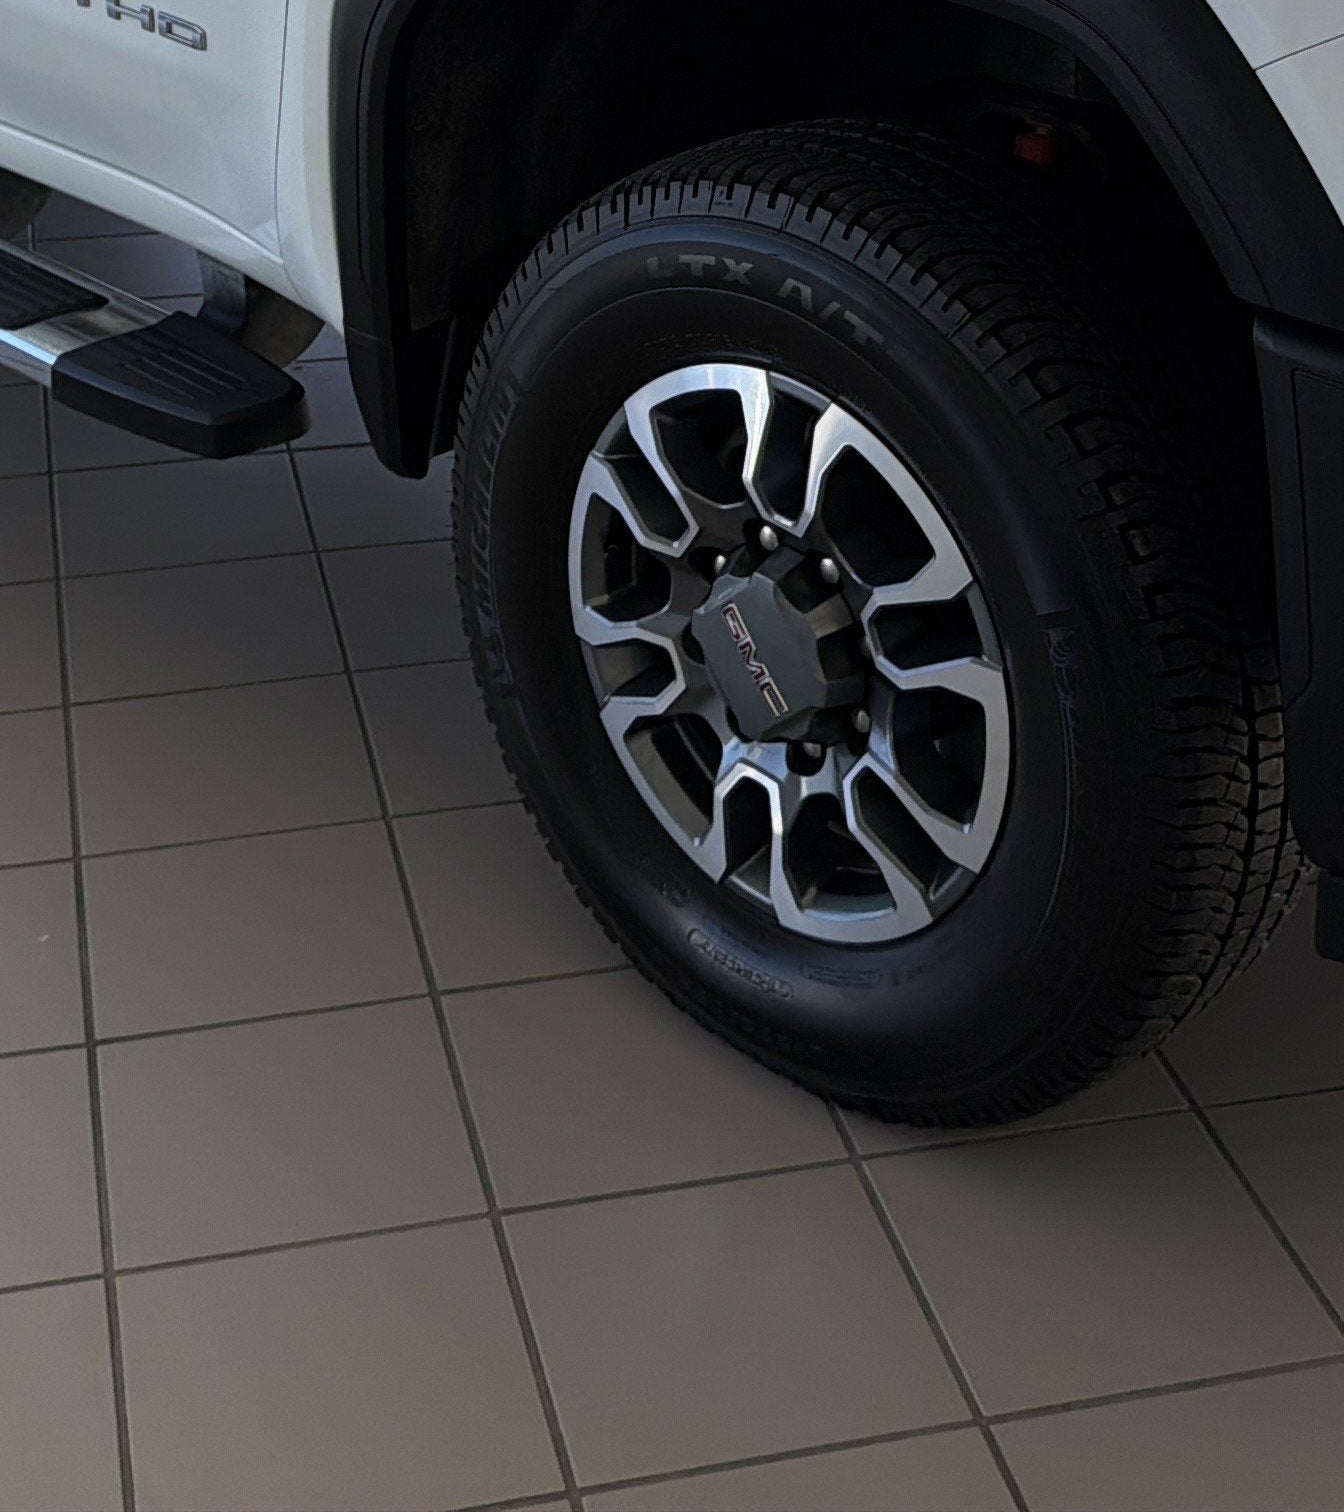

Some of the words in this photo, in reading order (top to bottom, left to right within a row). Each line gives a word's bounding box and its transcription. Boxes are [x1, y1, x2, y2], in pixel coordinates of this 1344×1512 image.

[646, 253, 754, 286] LTX
[778, 277, 885, 346] A/T
[721, 602, 790, 718] GMC
